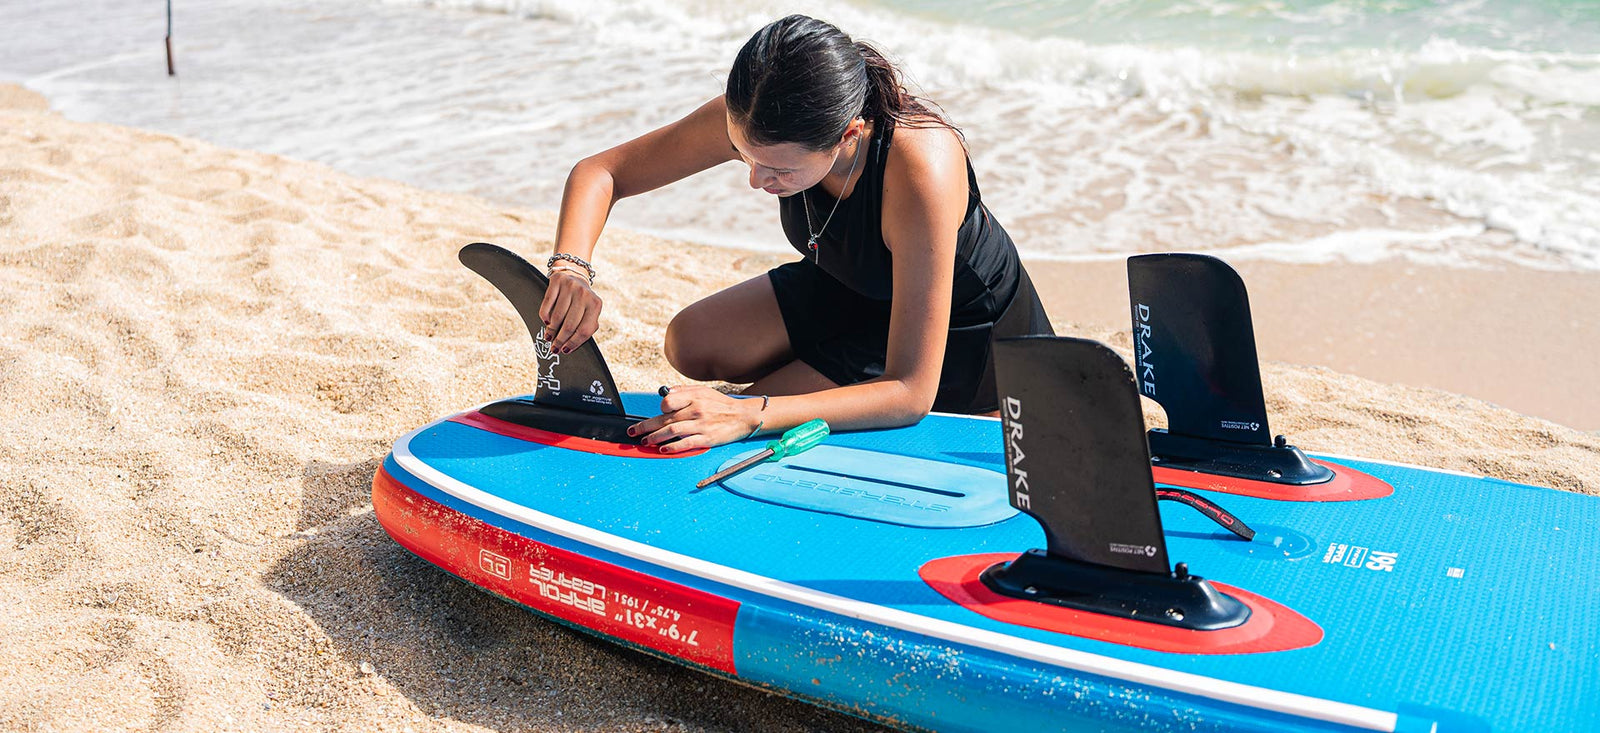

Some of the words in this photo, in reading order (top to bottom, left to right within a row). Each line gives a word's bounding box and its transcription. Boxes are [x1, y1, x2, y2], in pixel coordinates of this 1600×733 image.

[1138, 303, 1156, 396] DRAKE
[1006, 396, 1031, 510] DRAKE
[1365, 550, 1399, 573] 195
